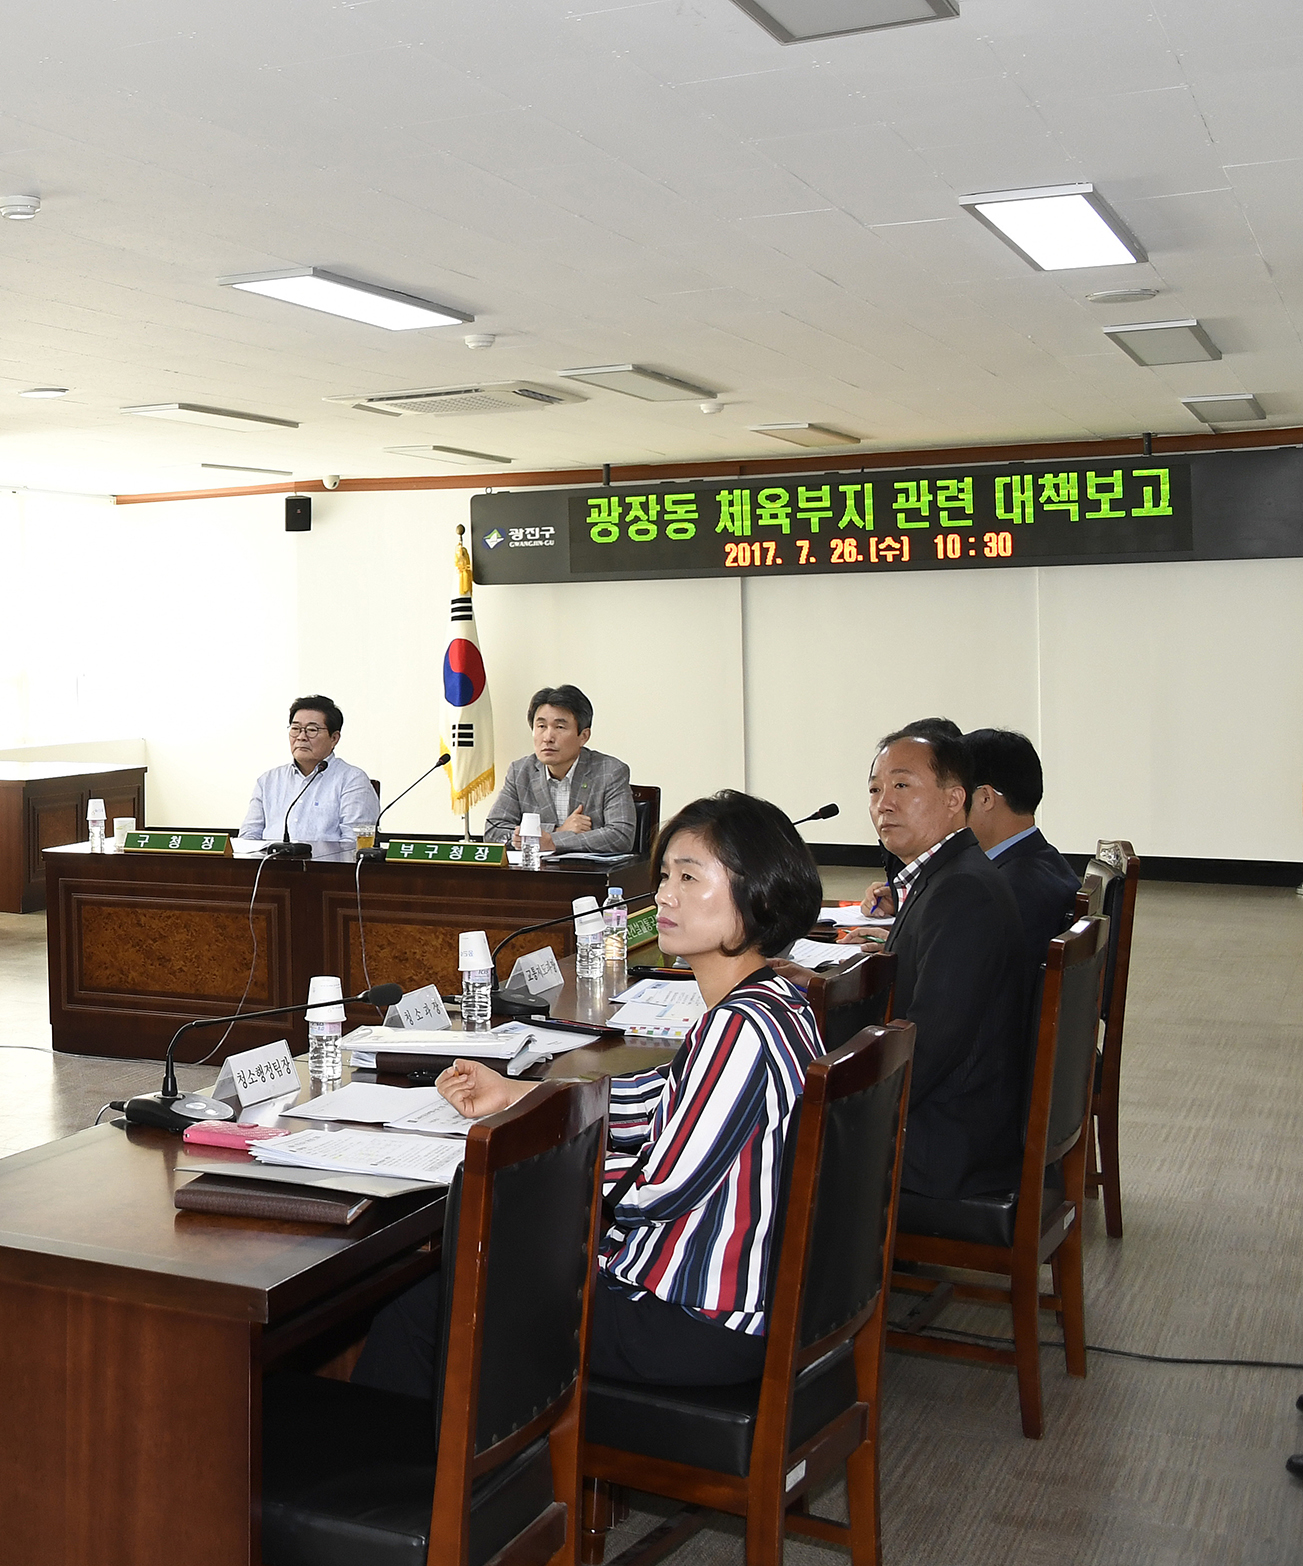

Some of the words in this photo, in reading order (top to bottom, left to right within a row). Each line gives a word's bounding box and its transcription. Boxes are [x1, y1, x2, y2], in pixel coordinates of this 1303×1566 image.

[586, 493, 699, 543] 광장동
[715, 483, 874, 536] 체육부지
[892, 476, 974, 529] 관련
[994, 467, 1173, 525] 대책보고
[508, 526, 555, 541] 광진구
[724, 541, 783, 567] 2017.
[796, 539, 817, 565] 7.
[403, 1001, 441, 1026] 청소과장
[236, 1056, 292, 1089] 청소행정팀장
